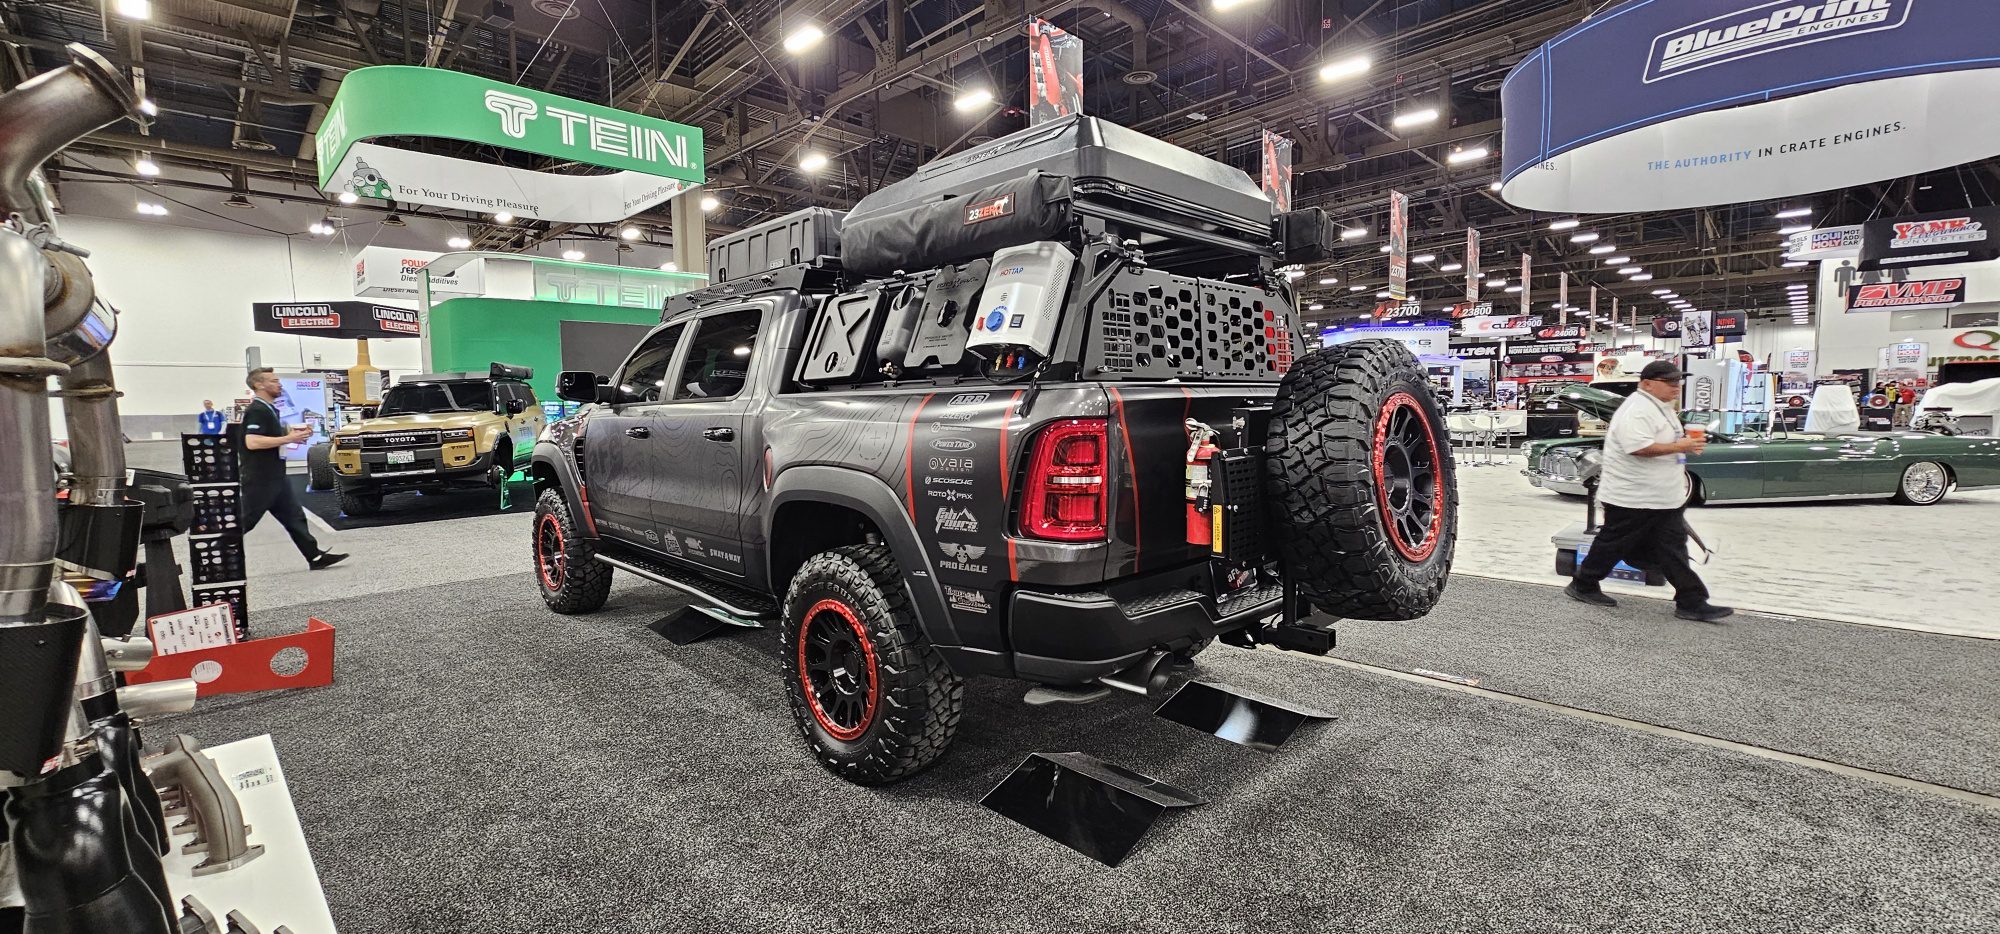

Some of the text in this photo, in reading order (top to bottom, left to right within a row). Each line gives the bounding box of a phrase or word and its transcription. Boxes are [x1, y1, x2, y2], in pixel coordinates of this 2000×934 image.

[1798, 13, 1880, 34] ENGINES
[545, 105, 688, 168] TEIN
[1648, 121, 1906, 171] THE AUTHORITY IN CRATE ENGINES.
[398, 185, 539, 212] For Your Driving Pleasure
[1812, 240, 1841, 249] MOLY
[1888, 279, 1962, 298] VMP
[1854, 294, 1956, 307] PERFORMANCE
[275, 306, 328, 317] LINCOLN
[375, 309, 414, 322] LINCOLN
[1386, 306, 1420, 317] 23700
[1462, 307, 1492, 317] 23800
[288, 318, 334, 326] ELECTRIC
[386, 321, 418, 332] ELECTRIC
[1516, 320, 1542, 328] 23900
[1449, 347, 1497, 356] ILLTEK
[950, 395, 985, 405] ARB
[932, 477, 974, 485] SCOSCHE
[940, 560, 988, 574] PRO EAGLE
